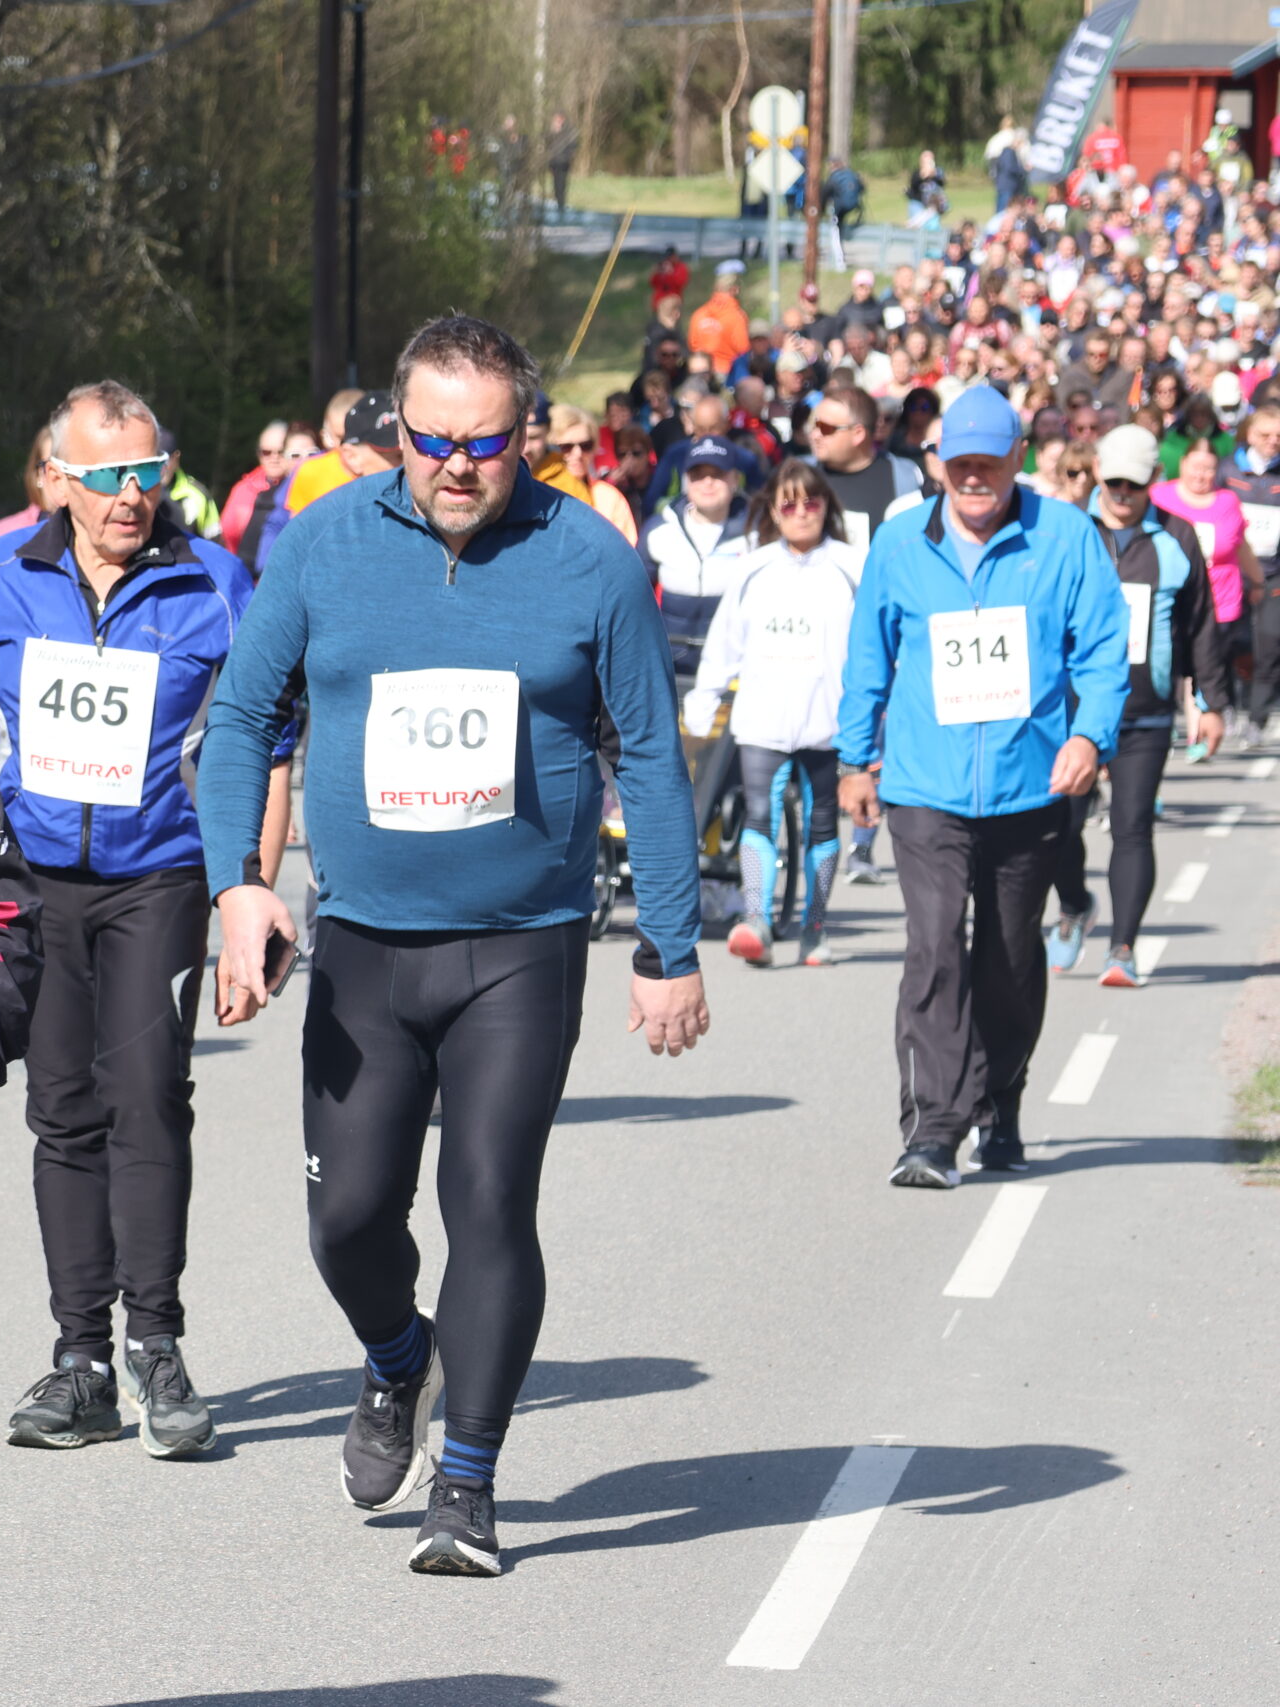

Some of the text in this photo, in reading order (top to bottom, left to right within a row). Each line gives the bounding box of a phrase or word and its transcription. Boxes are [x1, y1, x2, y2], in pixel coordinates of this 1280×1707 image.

[1031, 21, 1113, 173] BRUKET
[944, 635, 1010, 667] 314
[39, 678, 129, 726] 465
[391, 706, 488, 749] 360
[30, 754, 121, 779] RETURA
[380, 790, 490, 805] RETURA
